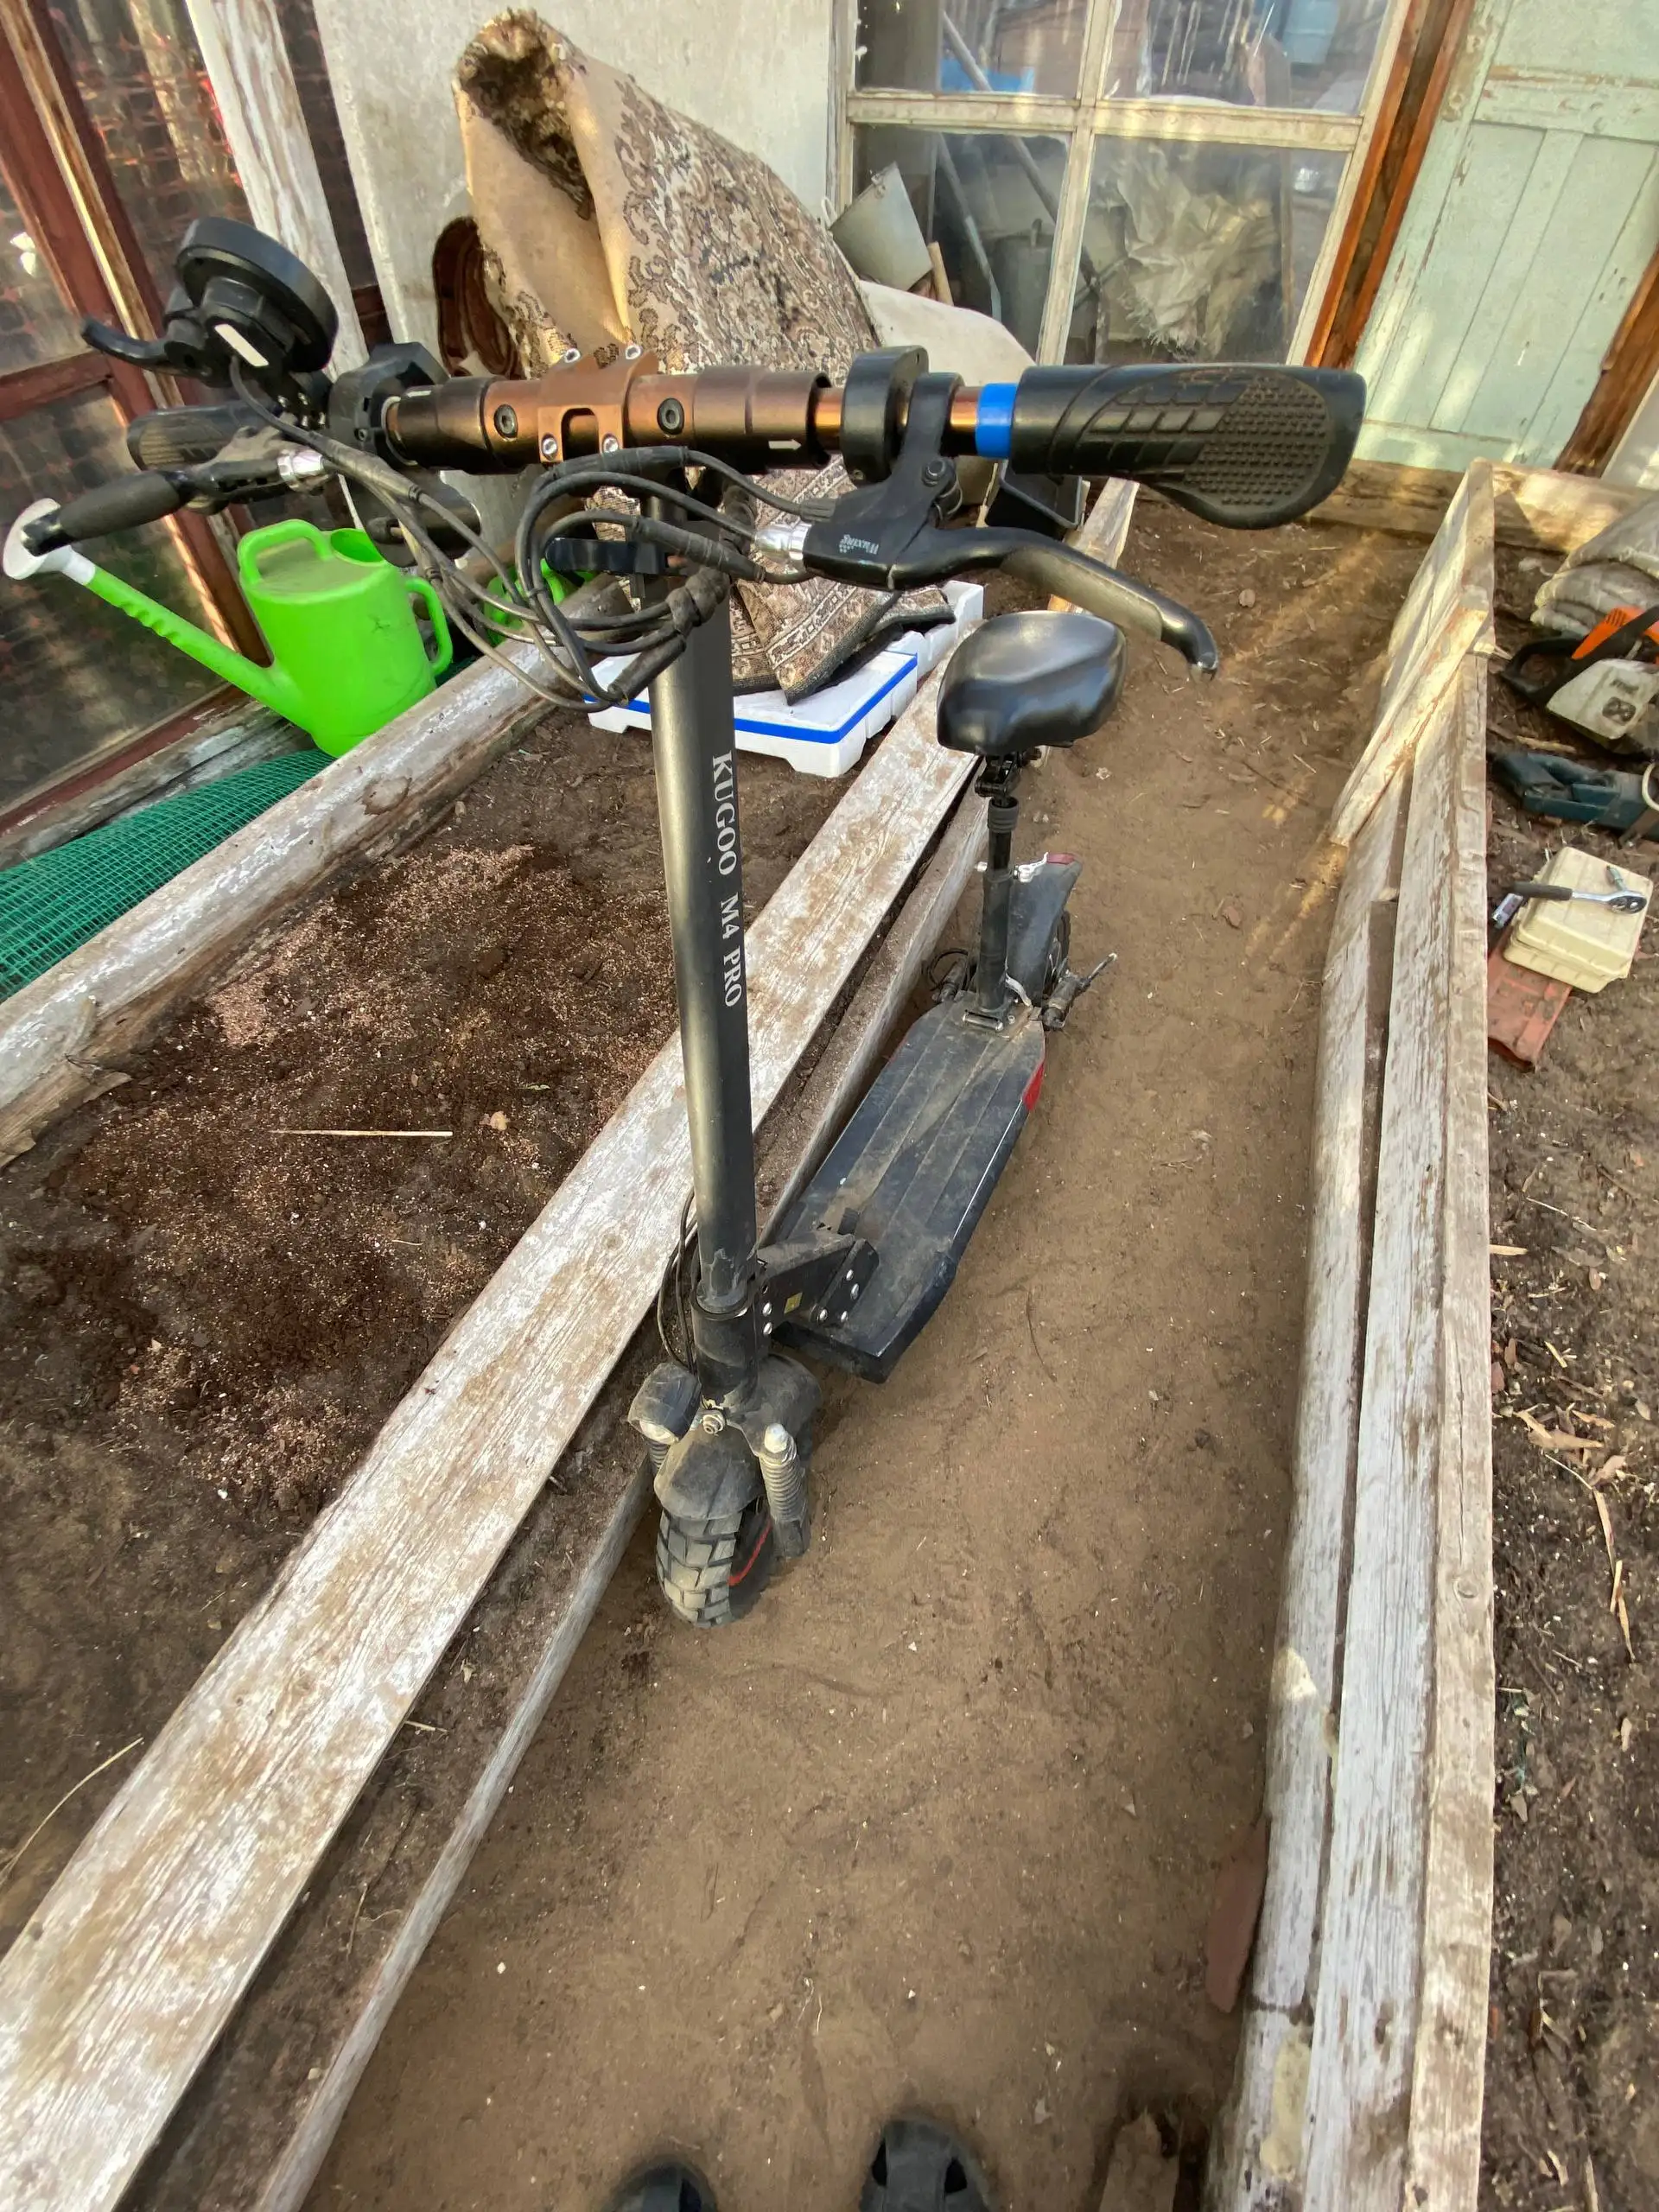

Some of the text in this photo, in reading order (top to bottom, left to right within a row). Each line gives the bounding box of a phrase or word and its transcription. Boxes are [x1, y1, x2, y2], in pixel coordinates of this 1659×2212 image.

[712, 750, 743, 1007] KUGOO M4 PRO
